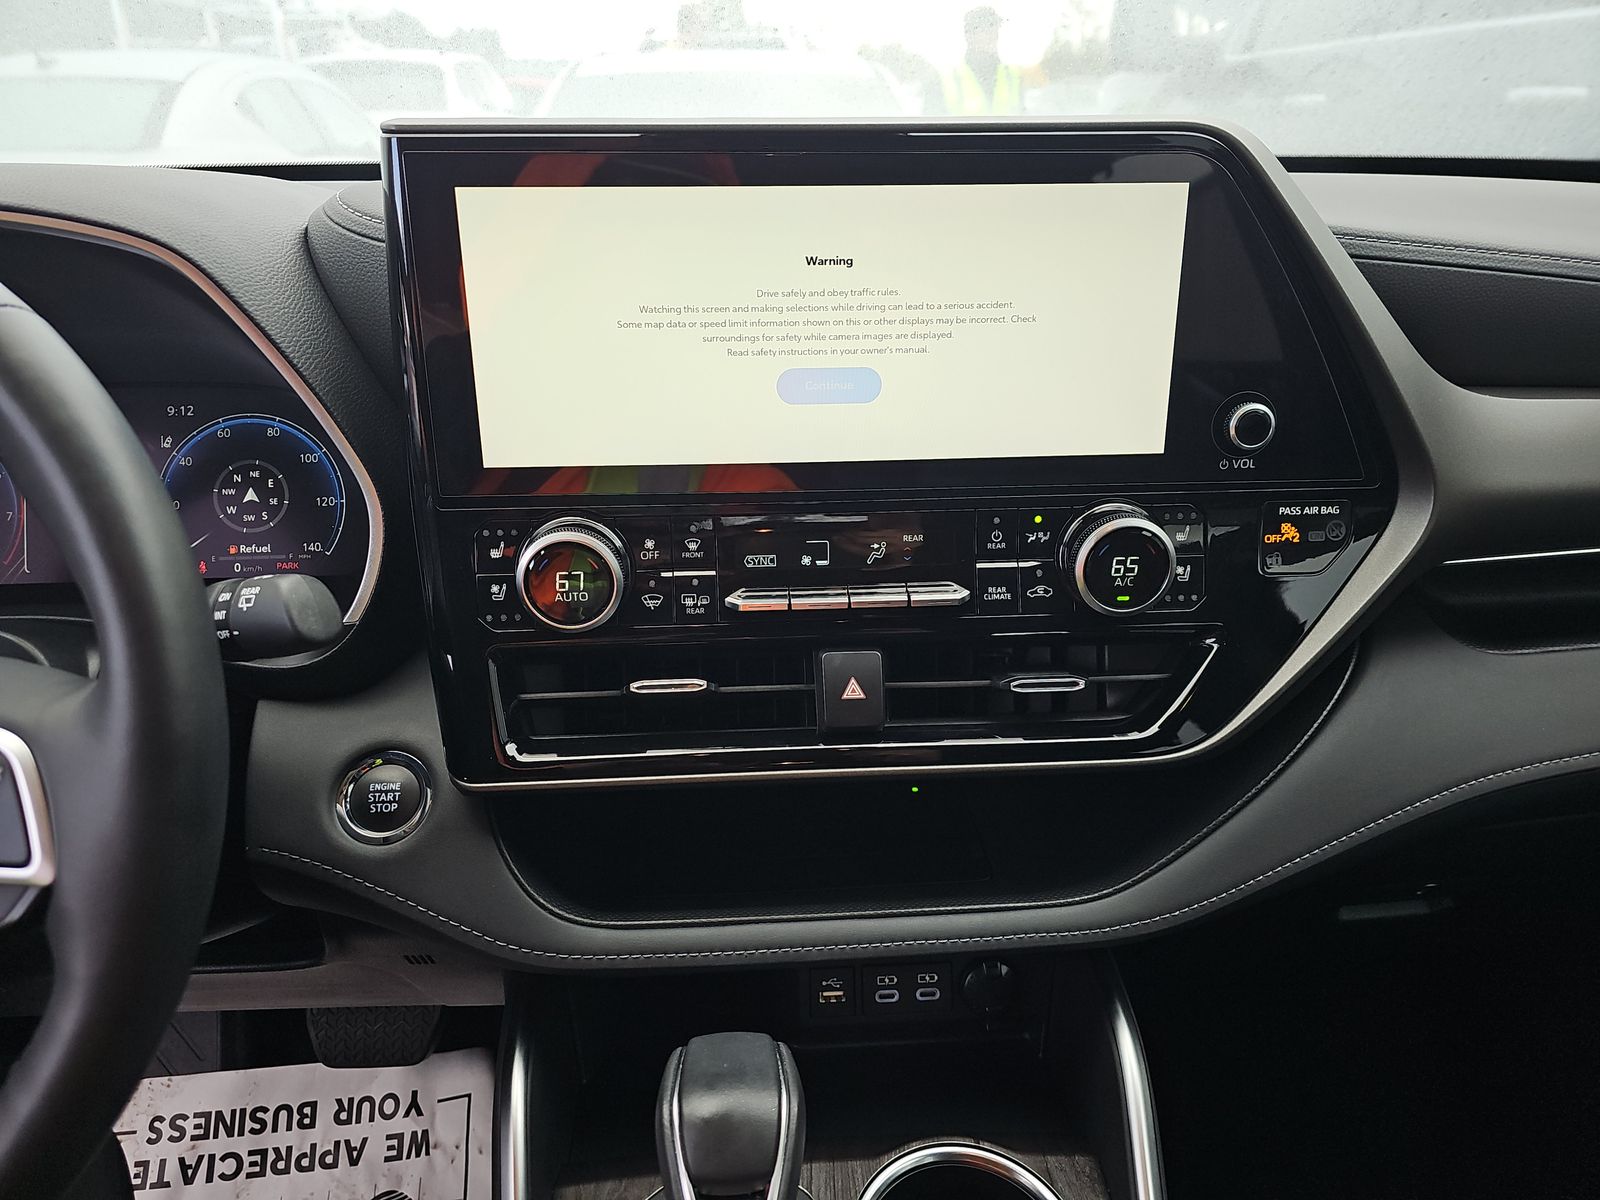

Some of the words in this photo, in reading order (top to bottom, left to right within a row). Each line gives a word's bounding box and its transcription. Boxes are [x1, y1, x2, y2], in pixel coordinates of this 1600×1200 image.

[805, 255, 853, 268] Warning
[756, 289, 779, 298] Drive
[781, 288, 807, 299] safely
[808, 288, 825, 297] and
[827, 288, 849, 299] obey
[850, 288, 876, 297] traffic
[877, 288, 901, 296] rules.
[639, 305, 682, 315] Watching
[683, 305, 700, 313] this
[701, 305, 731, 313] screen
[732, 304, 749, 313] and
[751, 304, 784, 314] making
[785, 304, 829, 312] selections
[831, 303, 854, 312] while
[856, 303, 886, 313] driving
[905, 302, 924, 310] lead
[926, 302, 935, 310] to
[943, 301, 975, 310] serious
[976, 301, 1016, 309] accident.
[617, 320, 642, 329] Some
[644, 322, 665, 330] map
[666, 320, 687, 328] data
[699, 319, 727, 329] speed
[728, 319, 748, 328] limit
[750, 319, 800, 327] information
[802, 318, 830, 327] shown
[846, 317, 861, 326] this
[863, 318, 872, 326] or
[873, 317, 897, 326] other
[898, 317, 934, 327] displays
[935, 317, 954, 326] may
[956, 316, 967, 324] be
[968, 315, 1009, 324] incorrect.
[1010, 314, 1037, 323] Check
[702, 334, 759, 344] surroundings
[762, 333, 774, 342] for
[776, 333, 801, 343] safety
[804, 333, 827, 341] while
[828, 333, 860, 341] camera
[862, 332, 893, 342] images
[910, 330, 954, 341] displayed.
[727, 348, 749, 357] Read
[751, 347, 776, 357] safety
[778, 347, 828, 356] instructions
[830, 347, 838, 355] in
[840, 347, 859, 357] your
[860, 346, 893, 355] owner's
[895, 345, 930, 354] manual.
[805, 380, 854, 391] Continue
[167, 405, 194, 416] 9:12
[217, 428, 231, 438] 60
[267, 427, 280, 437] 80
[179, 456, 193, 467] 40
[300, 453, 319, 463] 100
[1233, 459, 1256, 469] VOL
[233, 474, 242, 483] N
[268, 479, 274, 488] E
[316, 496, 336, 507] 120
[226, 506, 238, 515] W
[1279, 506, 1301, 515] PASS
[1303, 506, 1319, 515] AIR
[1320, 505, 1340, 514] BAG
[6, 511, 13, 521] 7
[261, 512, 268, 521] S
[903, 534, 924, 543] REAR
[1264, 534, 1282, 544] OFF
[1292, 532, 1300, 543] 2
[240, 543, 271, 553] Refuel
[302, 542, 322, 552] 140
[987, 542, 1006, 550] REAR
[640, 550, 660, 560] OFF
[681, 551, 704, 559] FRONT
[276, 562, 299, 570] PARK
[748, 556, 775, 566] SYNC
[234, 562, 241, 573] 0
[243, 565, 263, 573] km/h
[1111, 556, 1140, 577] 65
[555, 571, 584, 592] 67
[1114, 576, 1135, 587] A/C
[241, 586, 261, 595] REAR
[988, 586, 1007, 594] REAR
[218, 592, 233, 602] ON
[554, 591, 589, 603] AUTO
[983, 592, 1012, 601] CLIMATE
[686, 607, 705, 615] REAR
[216, 629, 230, 640] OFF
[369, 782, 401, 791] ENGINE
[368, 792, 401, 802] START
[370, 803, 398, 813] STOP
[333, 1089, 425, 1128] YOUR
[145, 1099, 319, 1146] BUSINESS
[383, 1128, 431, 1164] WE
[132, 1137, 369, 1191] APPRECIATE
